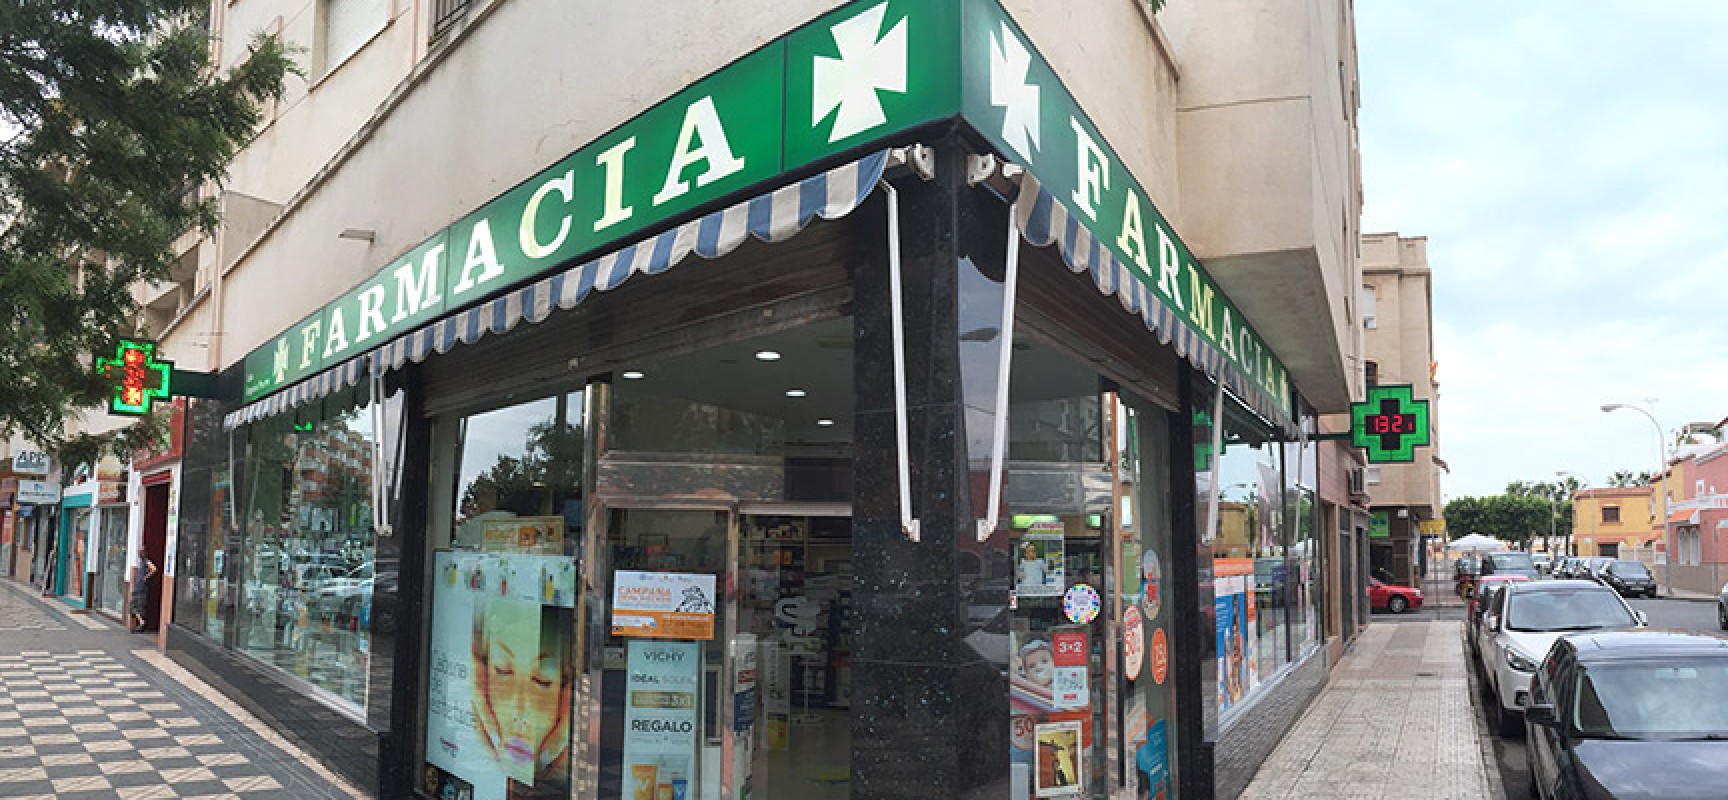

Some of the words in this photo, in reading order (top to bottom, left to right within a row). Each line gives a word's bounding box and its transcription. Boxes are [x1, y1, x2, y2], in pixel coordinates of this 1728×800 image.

[299, 95, 745, 371] FARMACIA
[1070, 115, 1277, 399] FARMACIA
[631, 719, 693, 733] REGALO
[643, 651, 684, 662] VICHY
